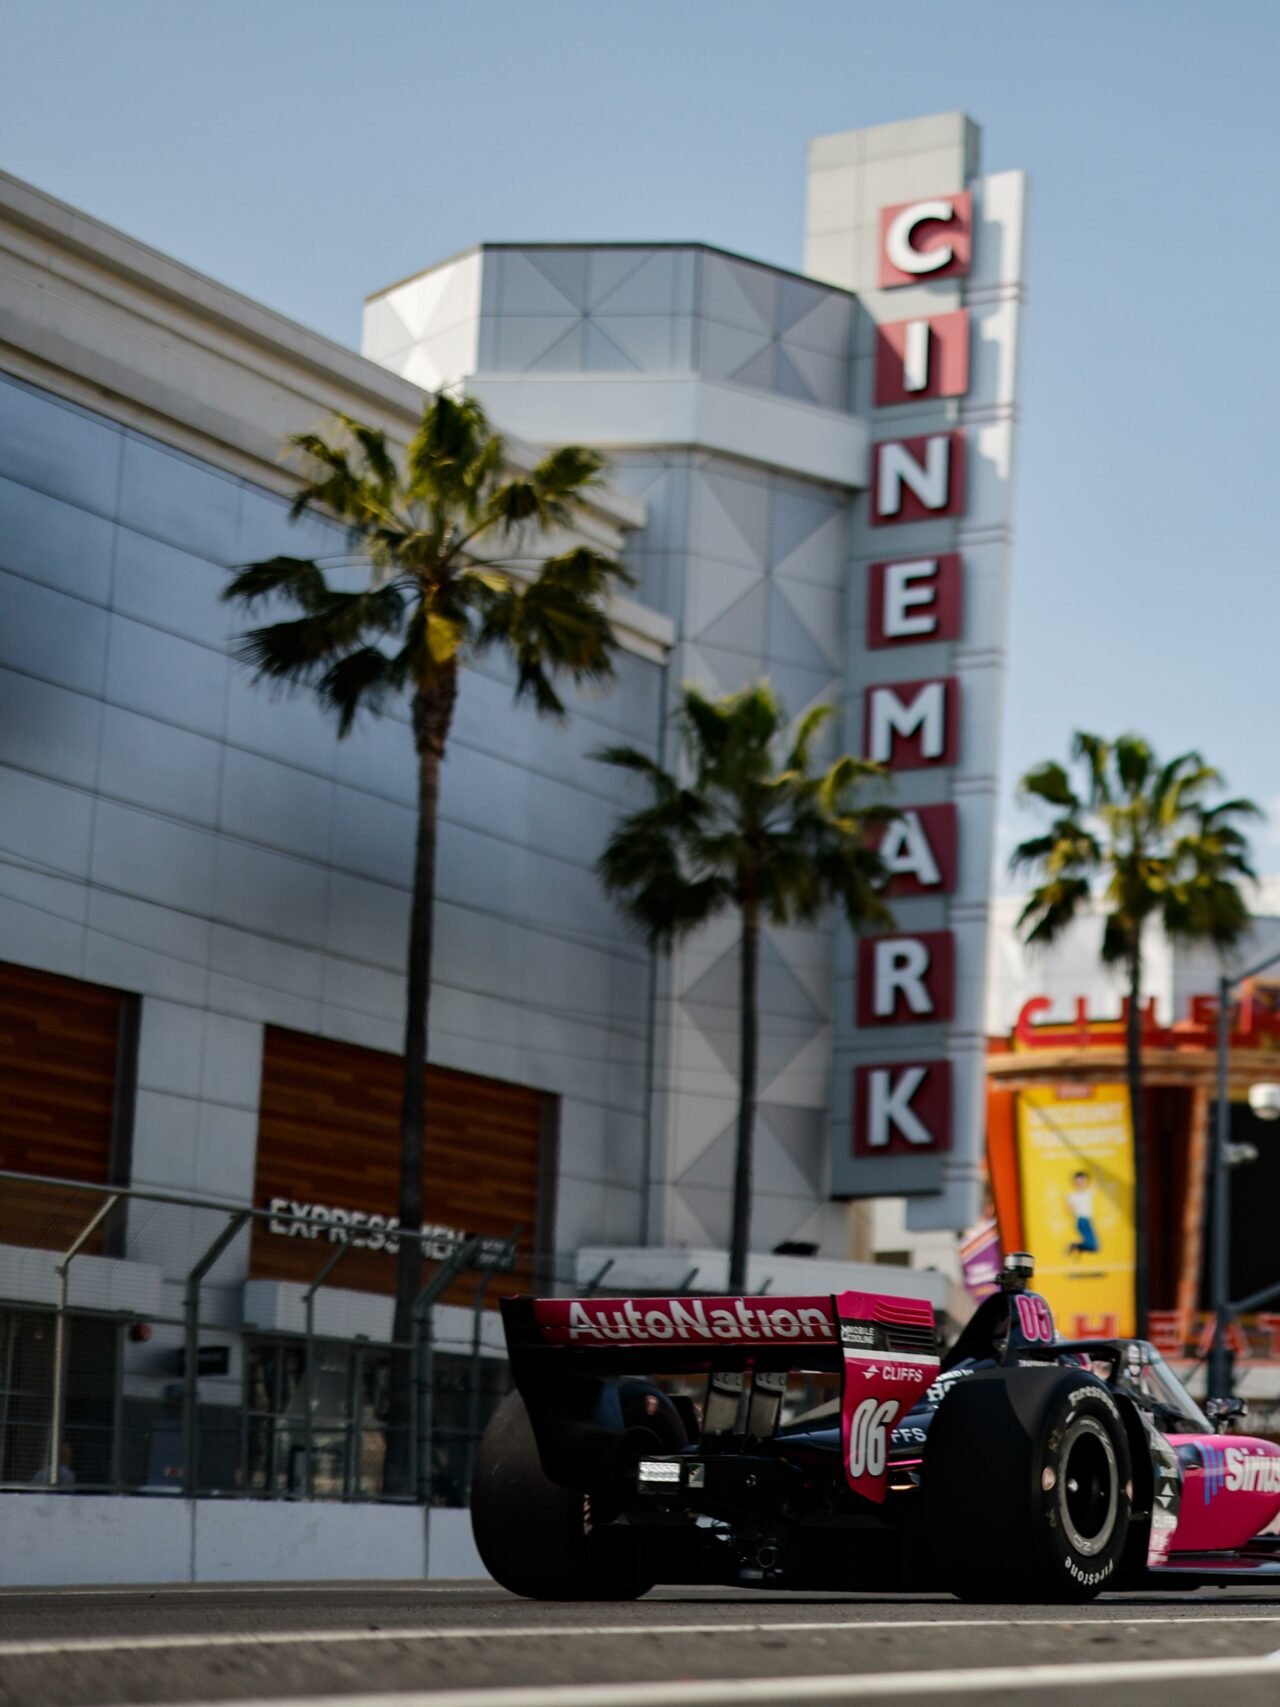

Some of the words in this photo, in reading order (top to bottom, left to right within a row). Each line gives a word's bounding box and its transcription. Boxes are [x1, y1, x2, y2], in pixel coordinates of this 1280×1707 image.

[866, 200, 955, 1147] CINEMARK
[268, 1197, 401, 1254] EXPRESS
[567, 1300, 832, 1341] AutoNation
[1015, 1294, 1053, 1343] 06
[882, 1365, 924, 1383] CLIFFS
[850, 1398, 900, 1478] 06
[1064, 1555, 1114, 1586] Firestone
